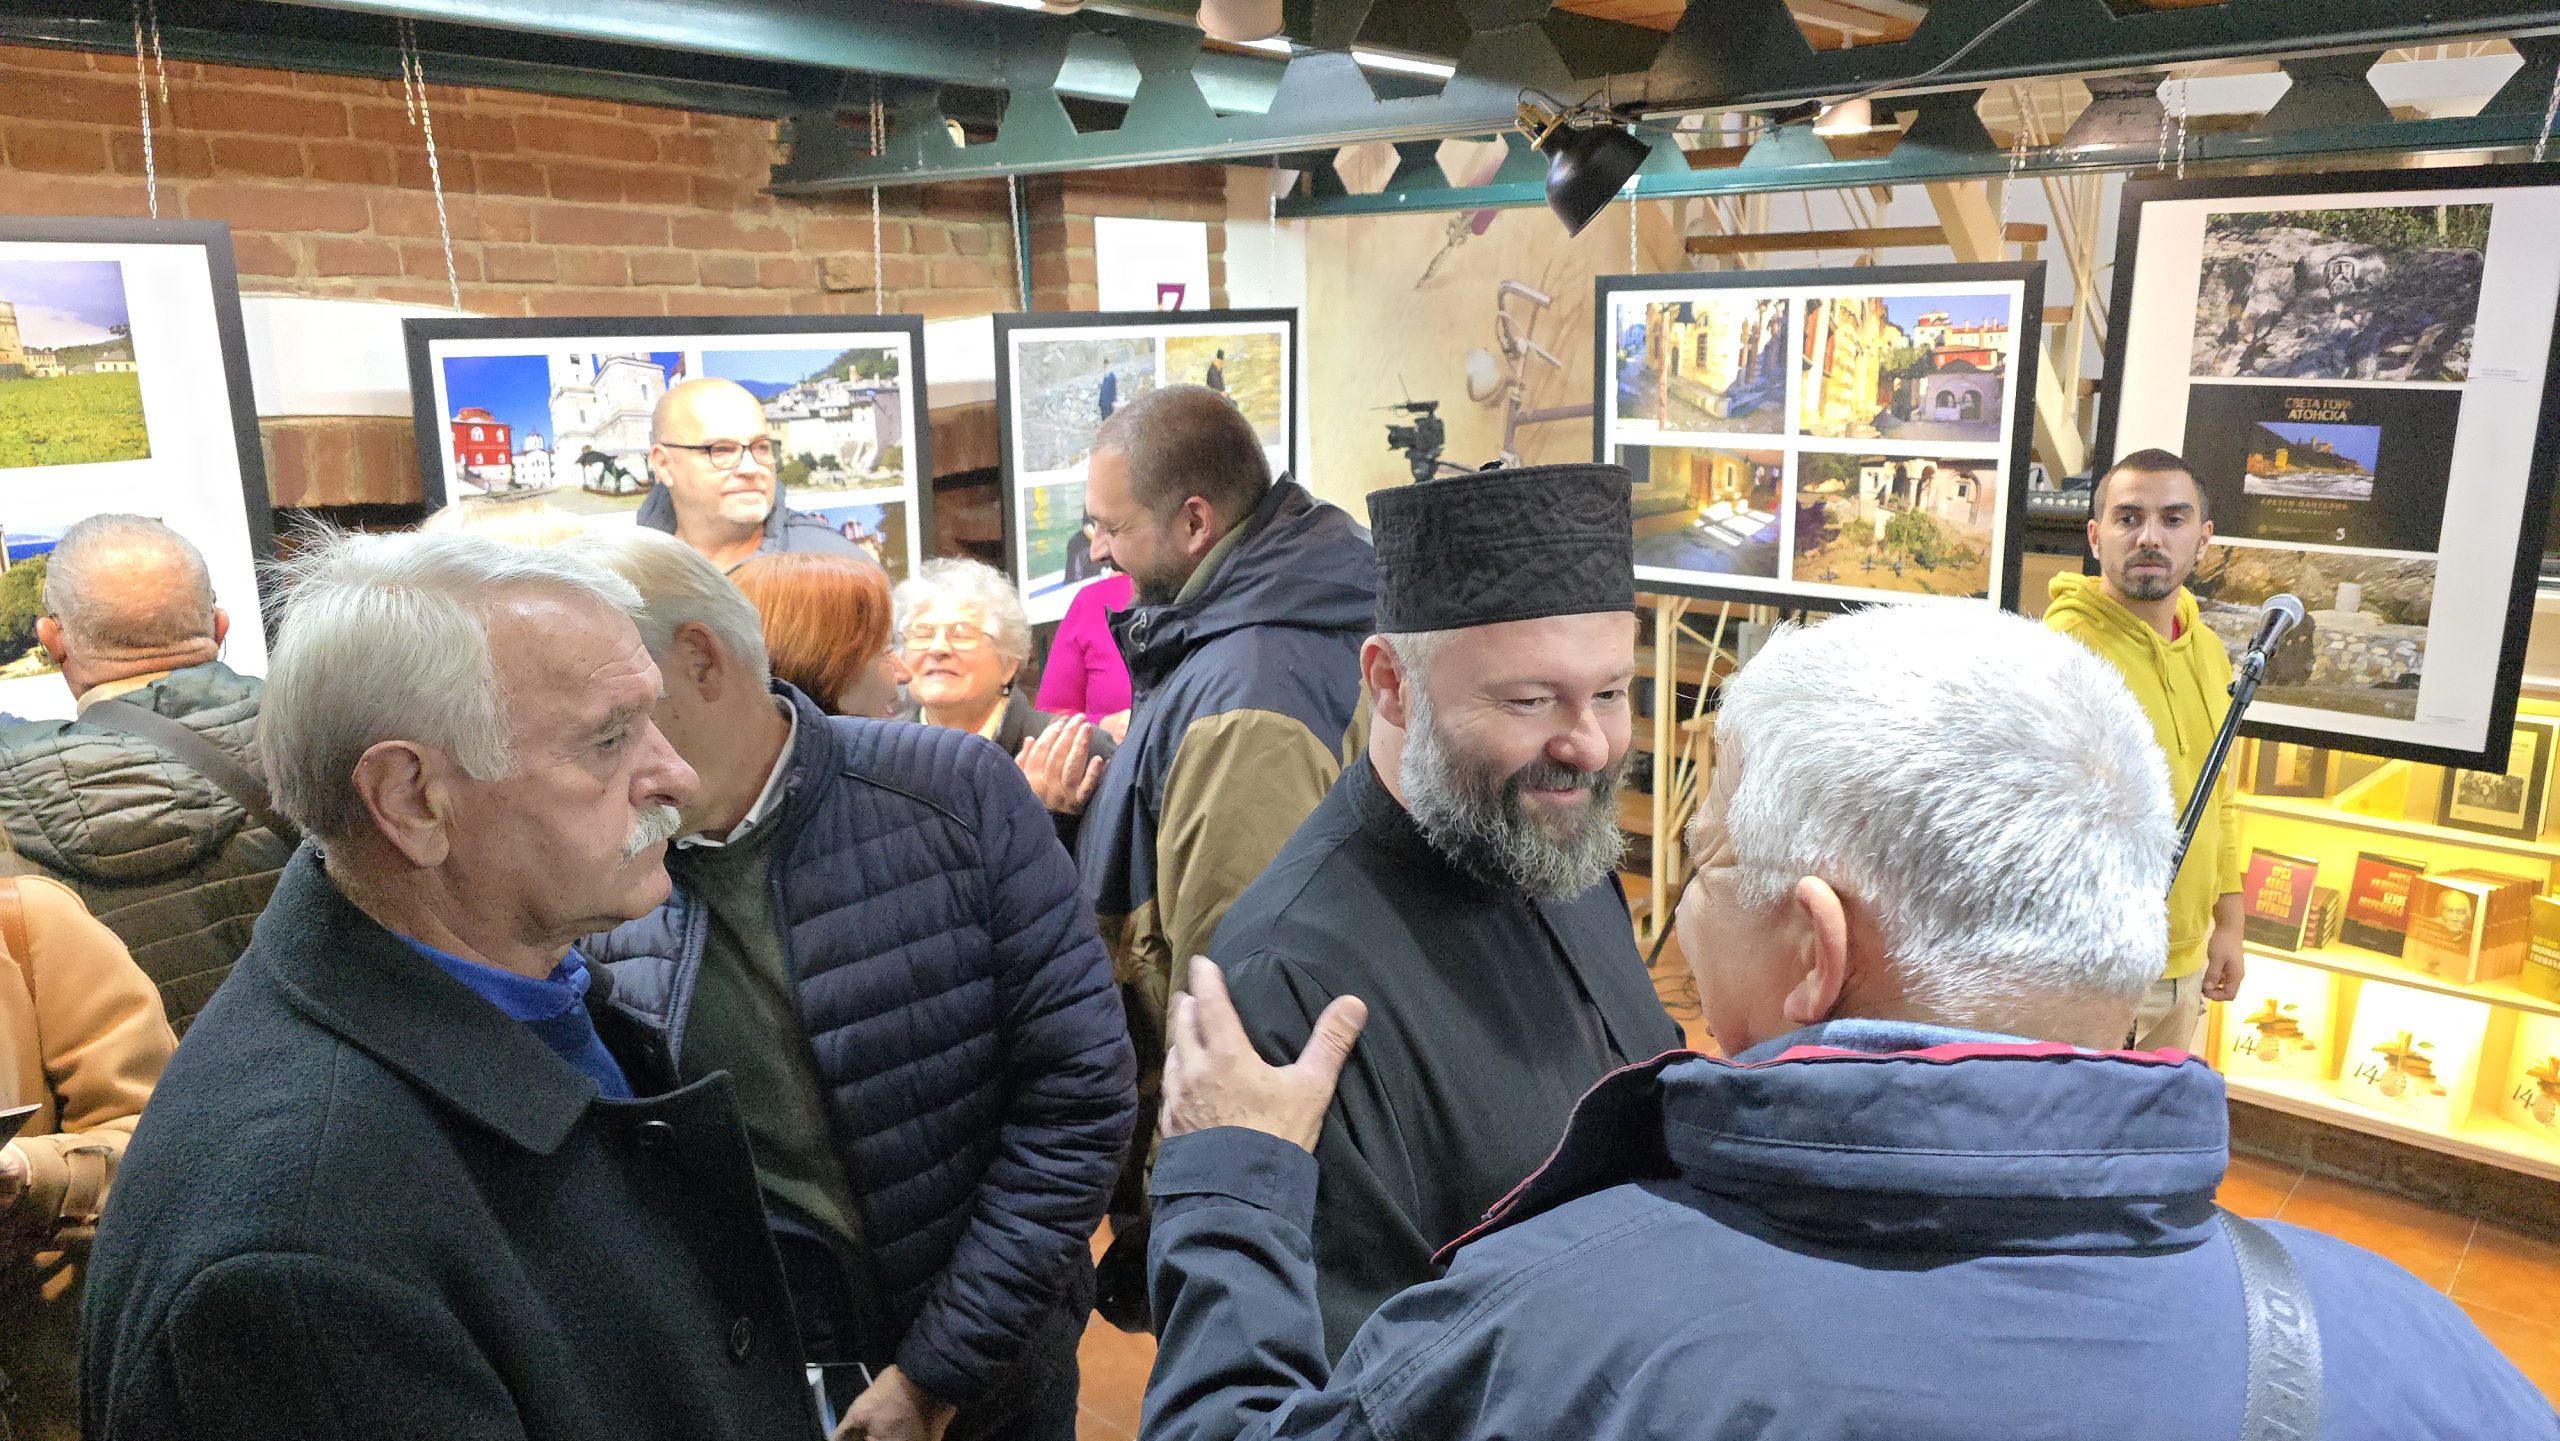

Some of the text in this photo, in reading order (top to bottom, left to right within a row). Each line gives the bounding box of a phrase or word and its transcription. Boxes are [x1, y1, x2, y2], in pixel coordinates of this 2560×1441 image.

[2288, 408, 2347, 422] АТОНСКА
[2353, 1061, 2382, 1085] 14
[2512, 1084, 2535, 1109] 14
